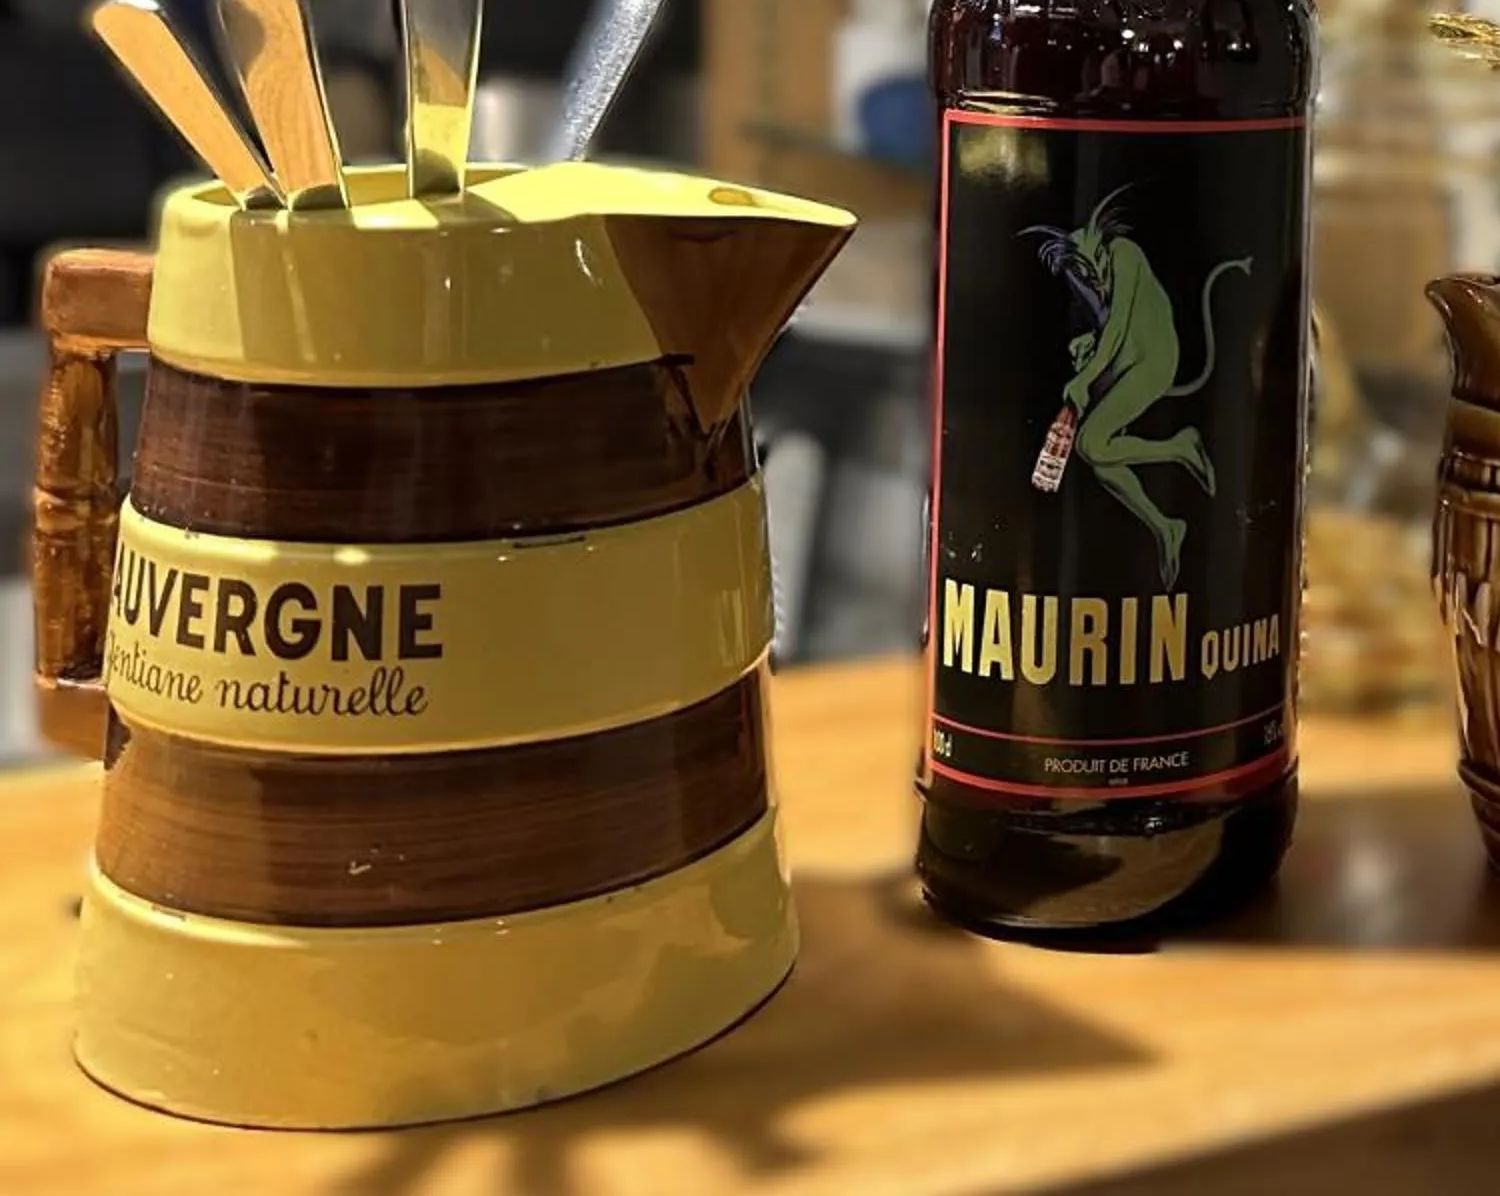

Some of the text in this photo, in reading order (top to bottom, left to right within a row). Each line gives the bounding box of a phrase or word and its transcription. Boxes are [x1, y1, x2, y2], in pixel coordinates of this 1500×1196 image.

[943, 577, 1280, 687] MAURIN QUINA
[214, 666, 430, 717] naturelle
[1044, 750, 1190, 774] PRODUIT DE FRANCE
